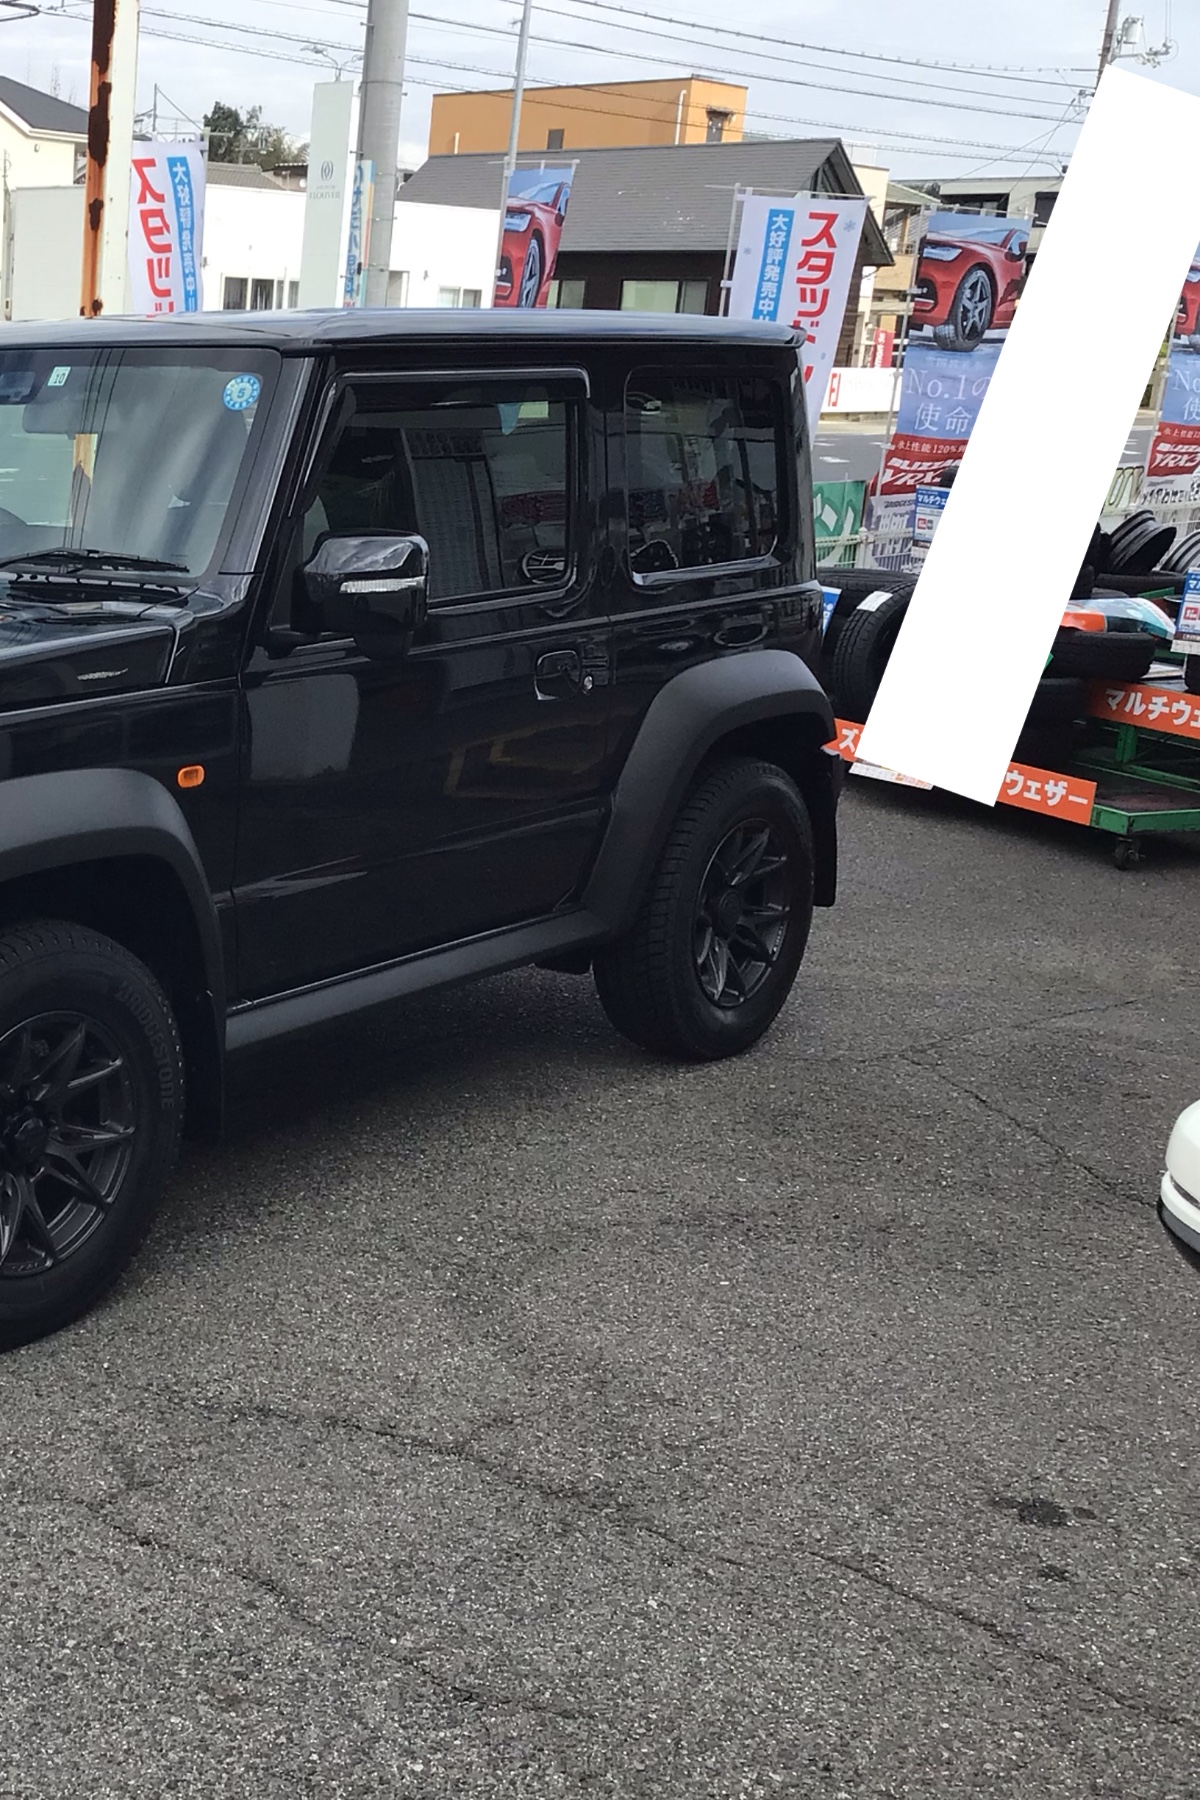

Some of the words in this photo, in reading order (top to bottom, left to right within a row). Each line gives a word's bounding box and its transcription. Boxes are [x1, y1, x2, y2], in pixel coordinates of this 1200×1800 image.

[758, 214, 789, 321] 大好評発売中
[53, 372, 66, 384] 10
[236, 388, 246, 399] 5
